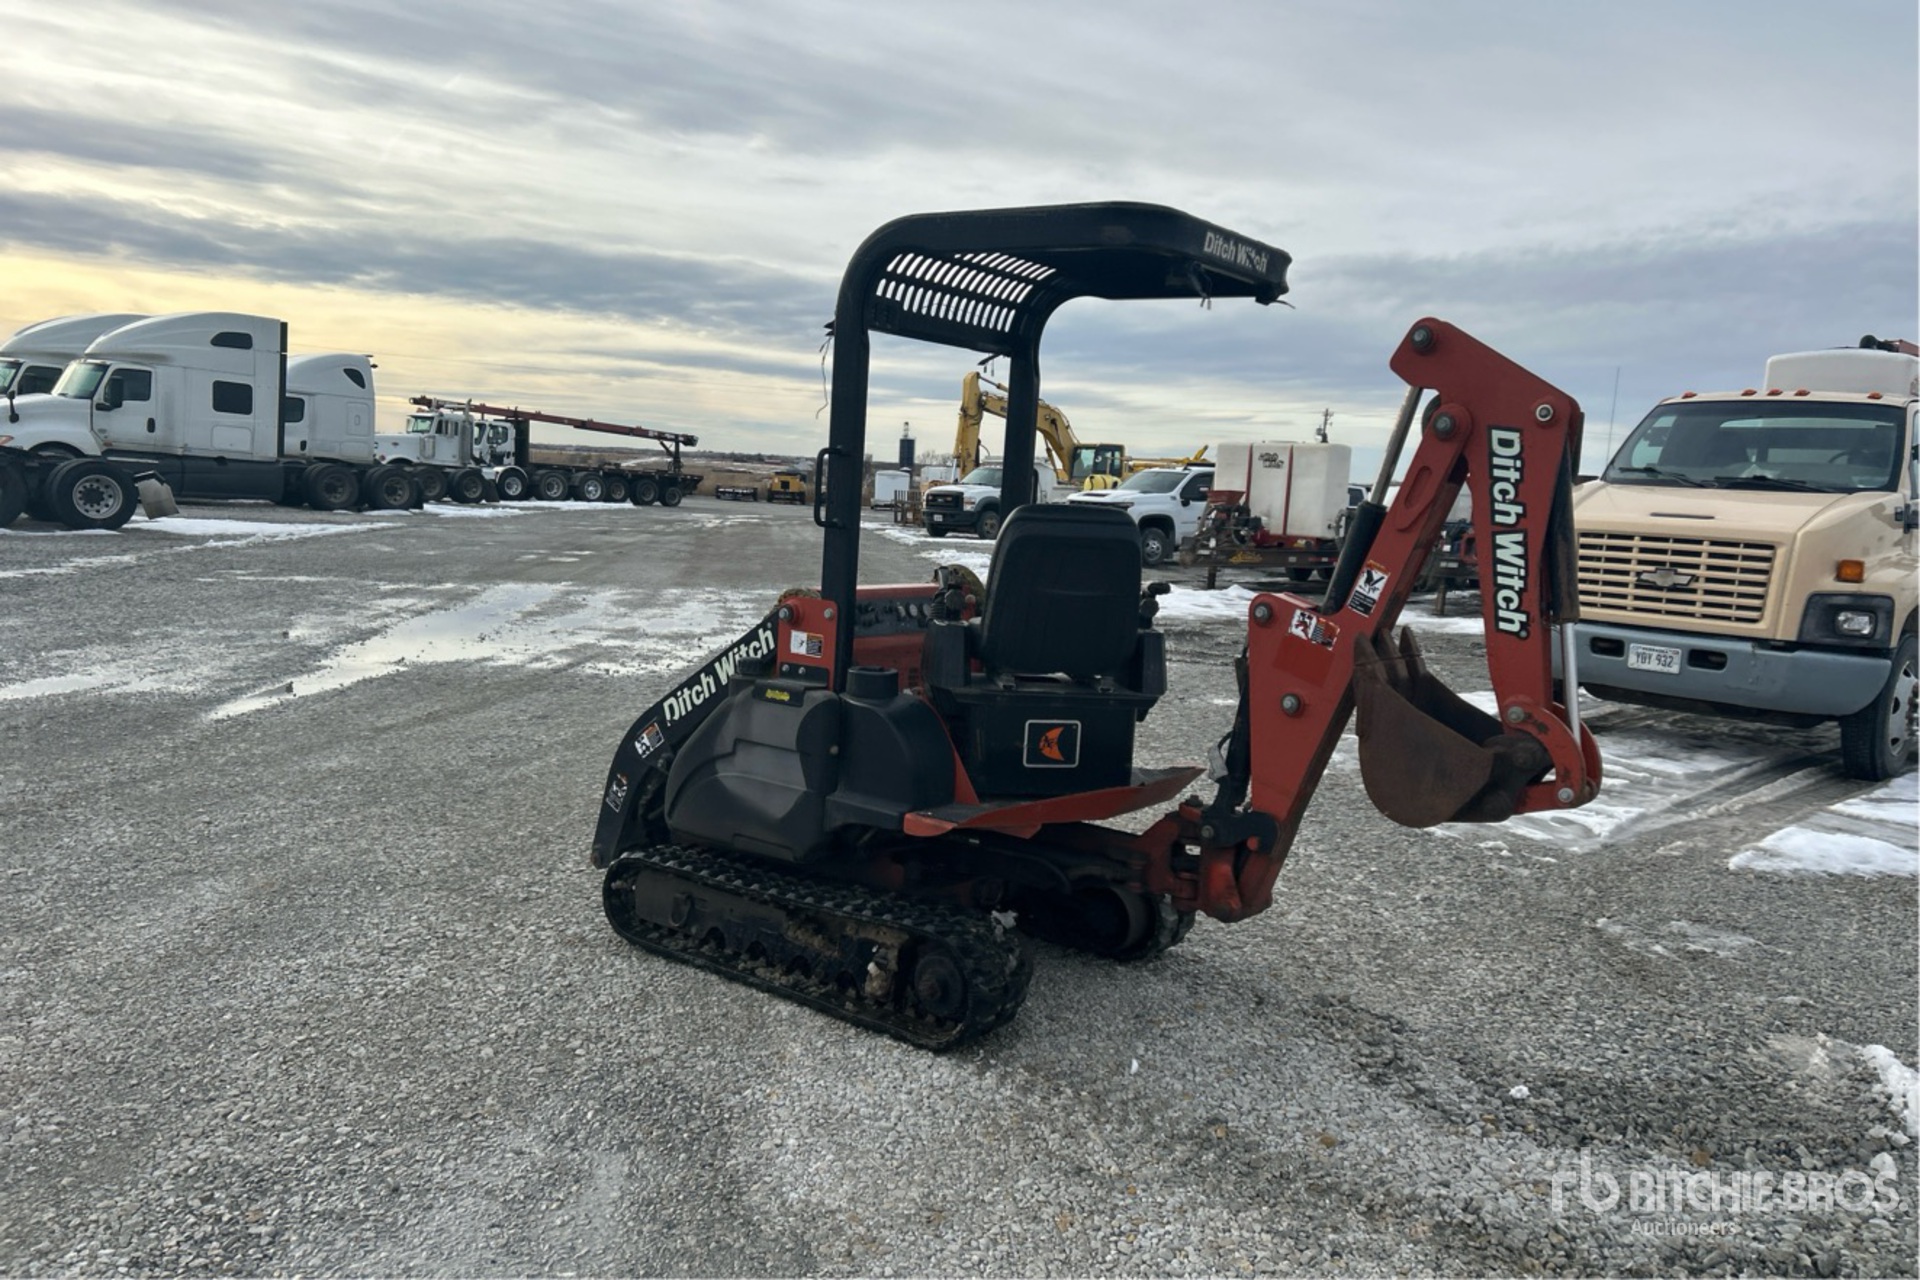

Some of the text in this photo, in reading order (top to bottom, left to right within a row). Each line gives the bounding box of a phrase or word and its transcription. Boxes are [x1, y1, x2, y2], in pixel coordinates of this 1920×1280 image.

[1203, 231, 1236, 261] Ditch
[1491, 429, 1524, 526] Ditch
[663, 672, 716, 727] Ditch
